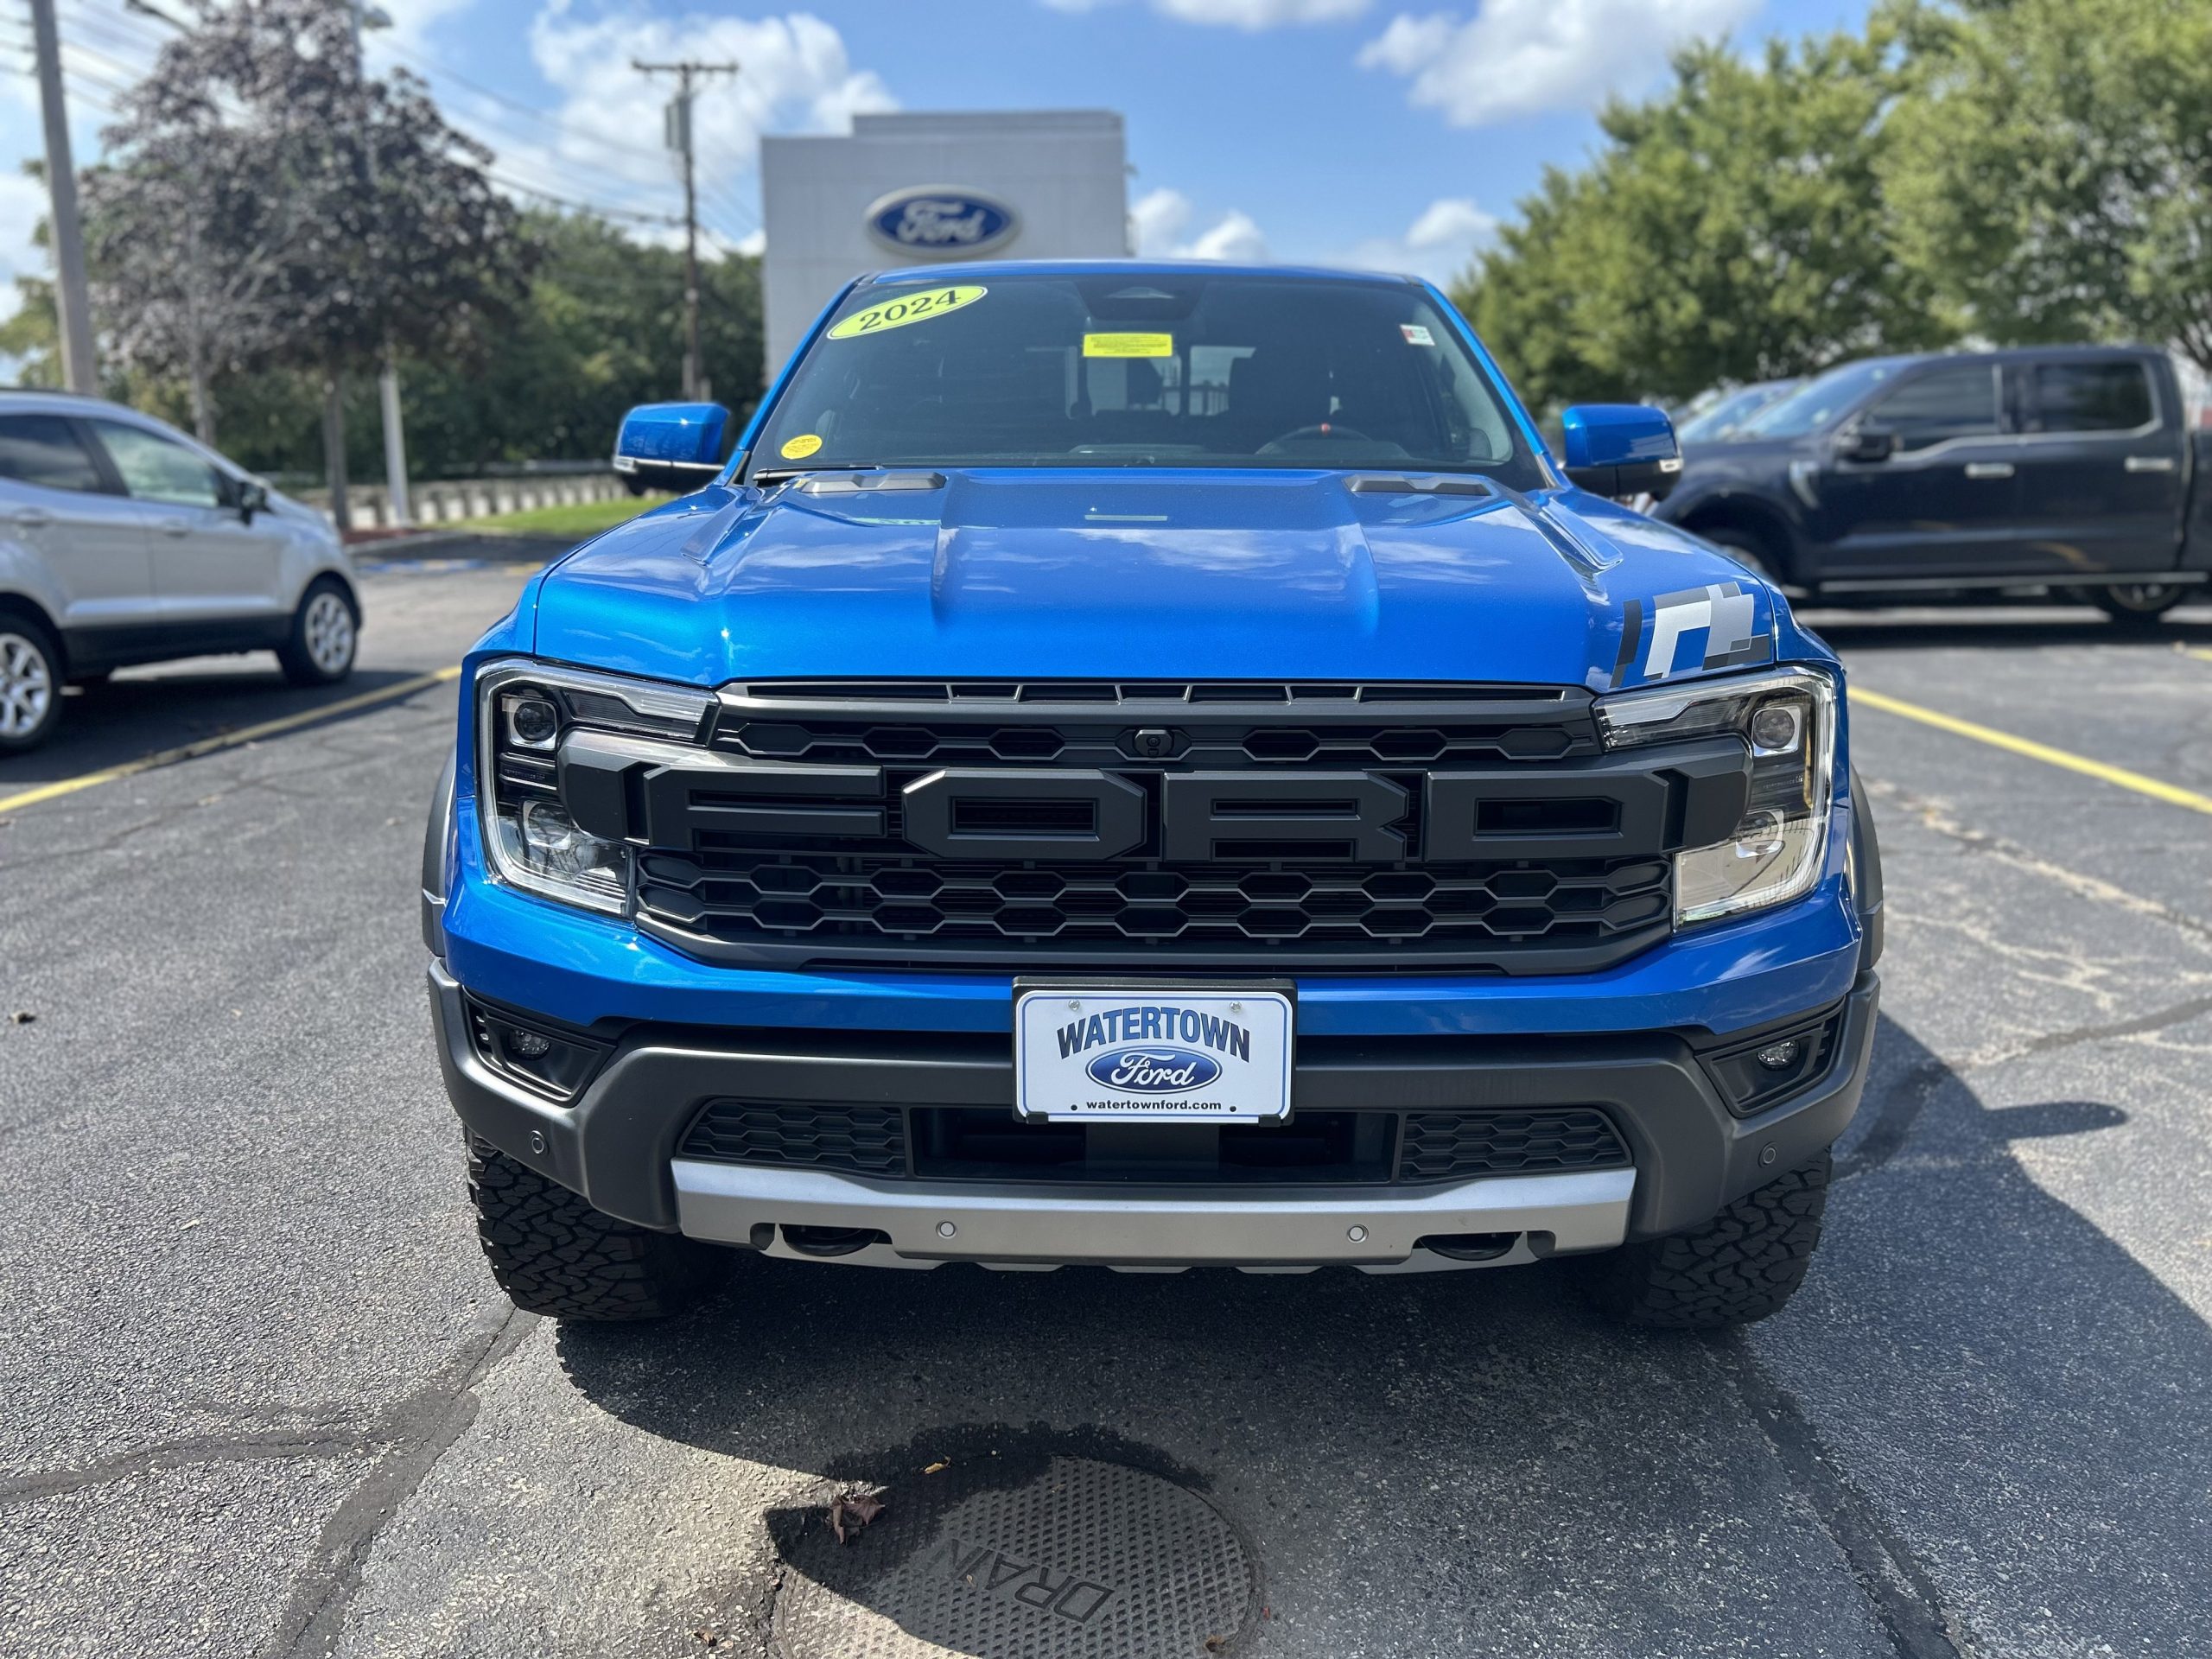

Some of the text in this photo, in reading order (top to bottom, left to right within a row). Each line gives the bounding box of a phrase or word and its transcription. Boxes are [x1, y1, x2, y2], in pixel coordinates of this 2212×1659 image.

[896, 200, 987, 244] Ford
[859, 289, 961, 331] 2024
[642, 766, 1669, 862] FORD
[1056, 1006, 1250, 1064] WATERTOWN
[1110, 1051, 1198, 1086] Ford
[1086, 1099, 1222, 1110] watertownford.com
[928, 1538, 1115, 1623] DRAIN
